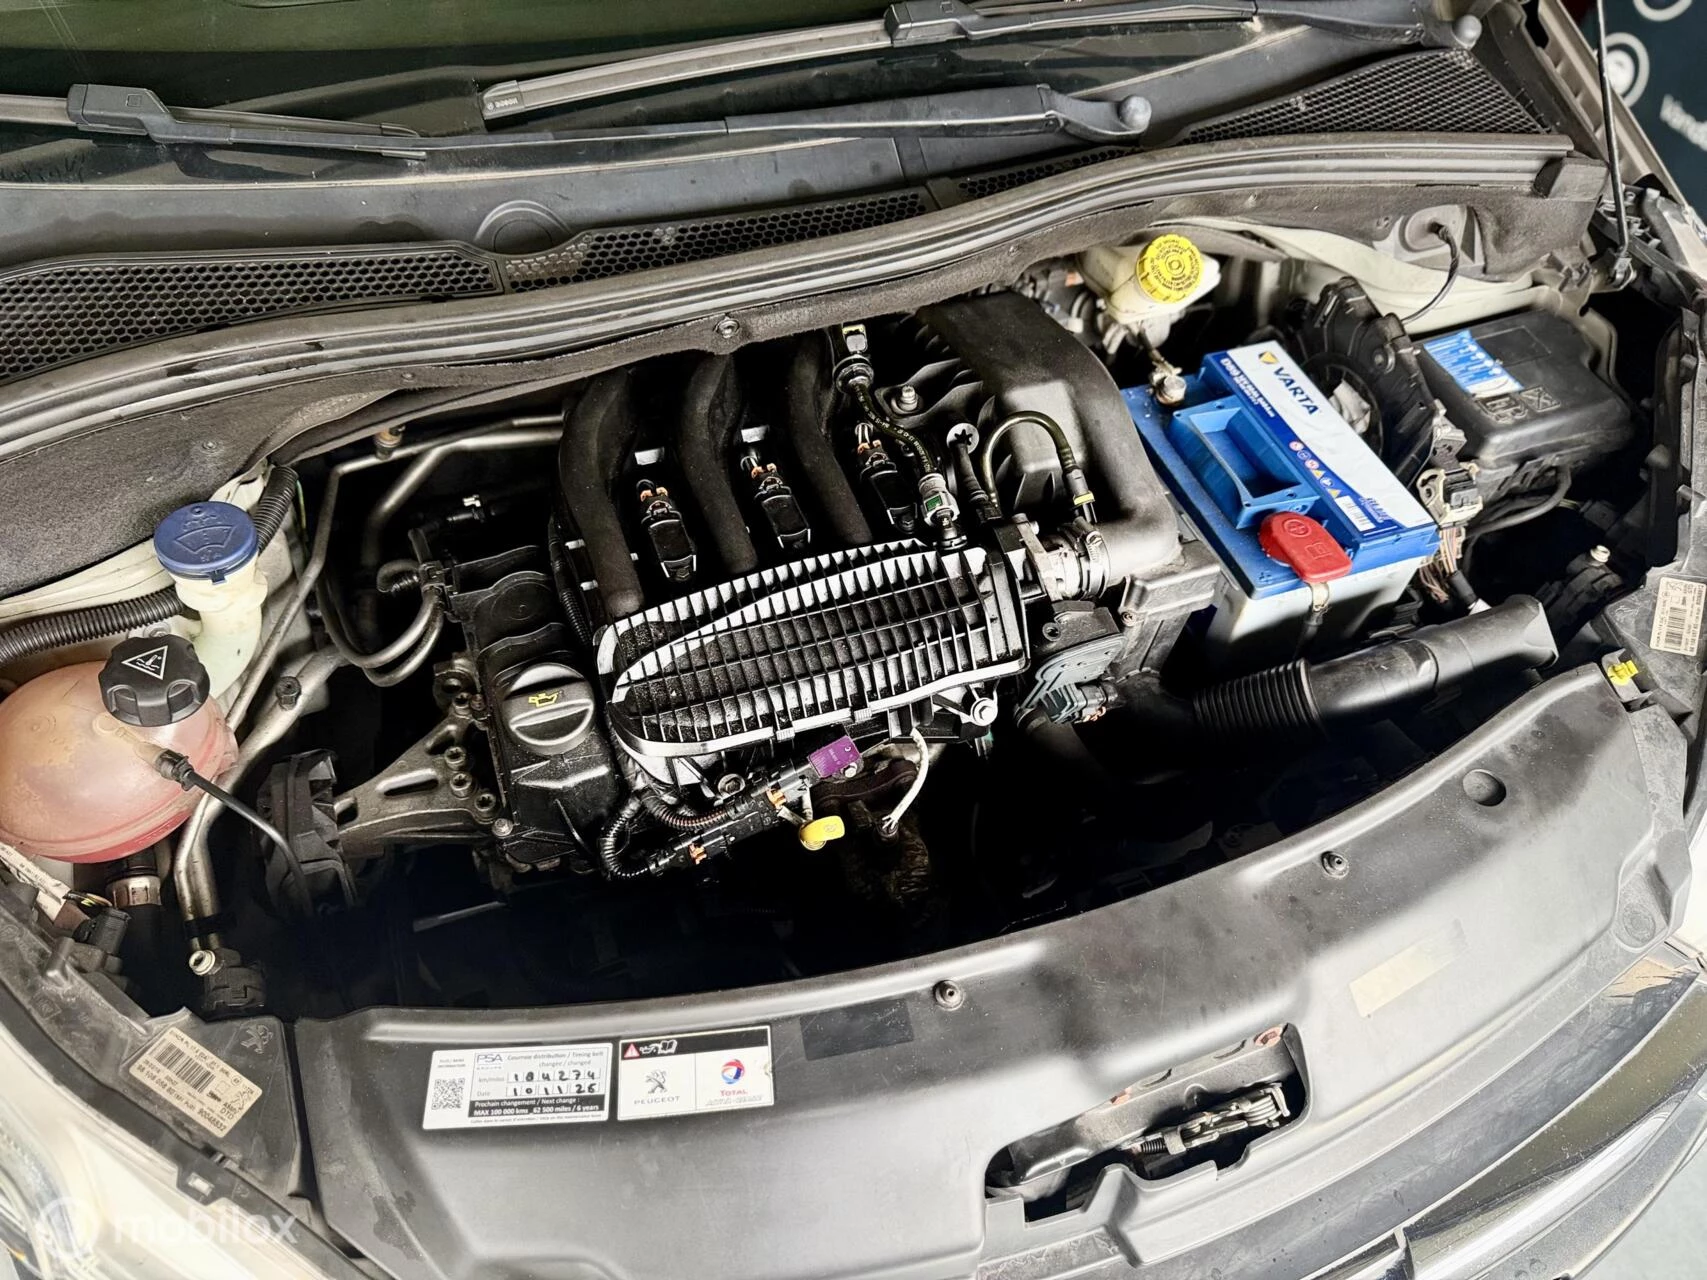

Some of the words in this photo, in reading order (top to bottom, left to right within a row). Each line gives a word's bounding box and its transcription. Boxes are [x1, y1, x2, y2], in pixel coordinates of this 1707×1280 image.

[1274, 366, 1319, 415] VARTA
[476, 1053, 503, 1063] PSA
[720, 1089, 748, 1097] TOTAL
[474, 1100, 500, 1108] Prochain
[500, 1099, 536, 1107] changement
[556, 1097, 577, 1105] change
[633, 1096, 681, 1106] PEUGEOT
[474, 1109, 490, 1117] MAX
[490, 1108, 502, 1116] 100
[502, 1108, 515, 1116] 000
[582, 1104, 600, 1112] years
